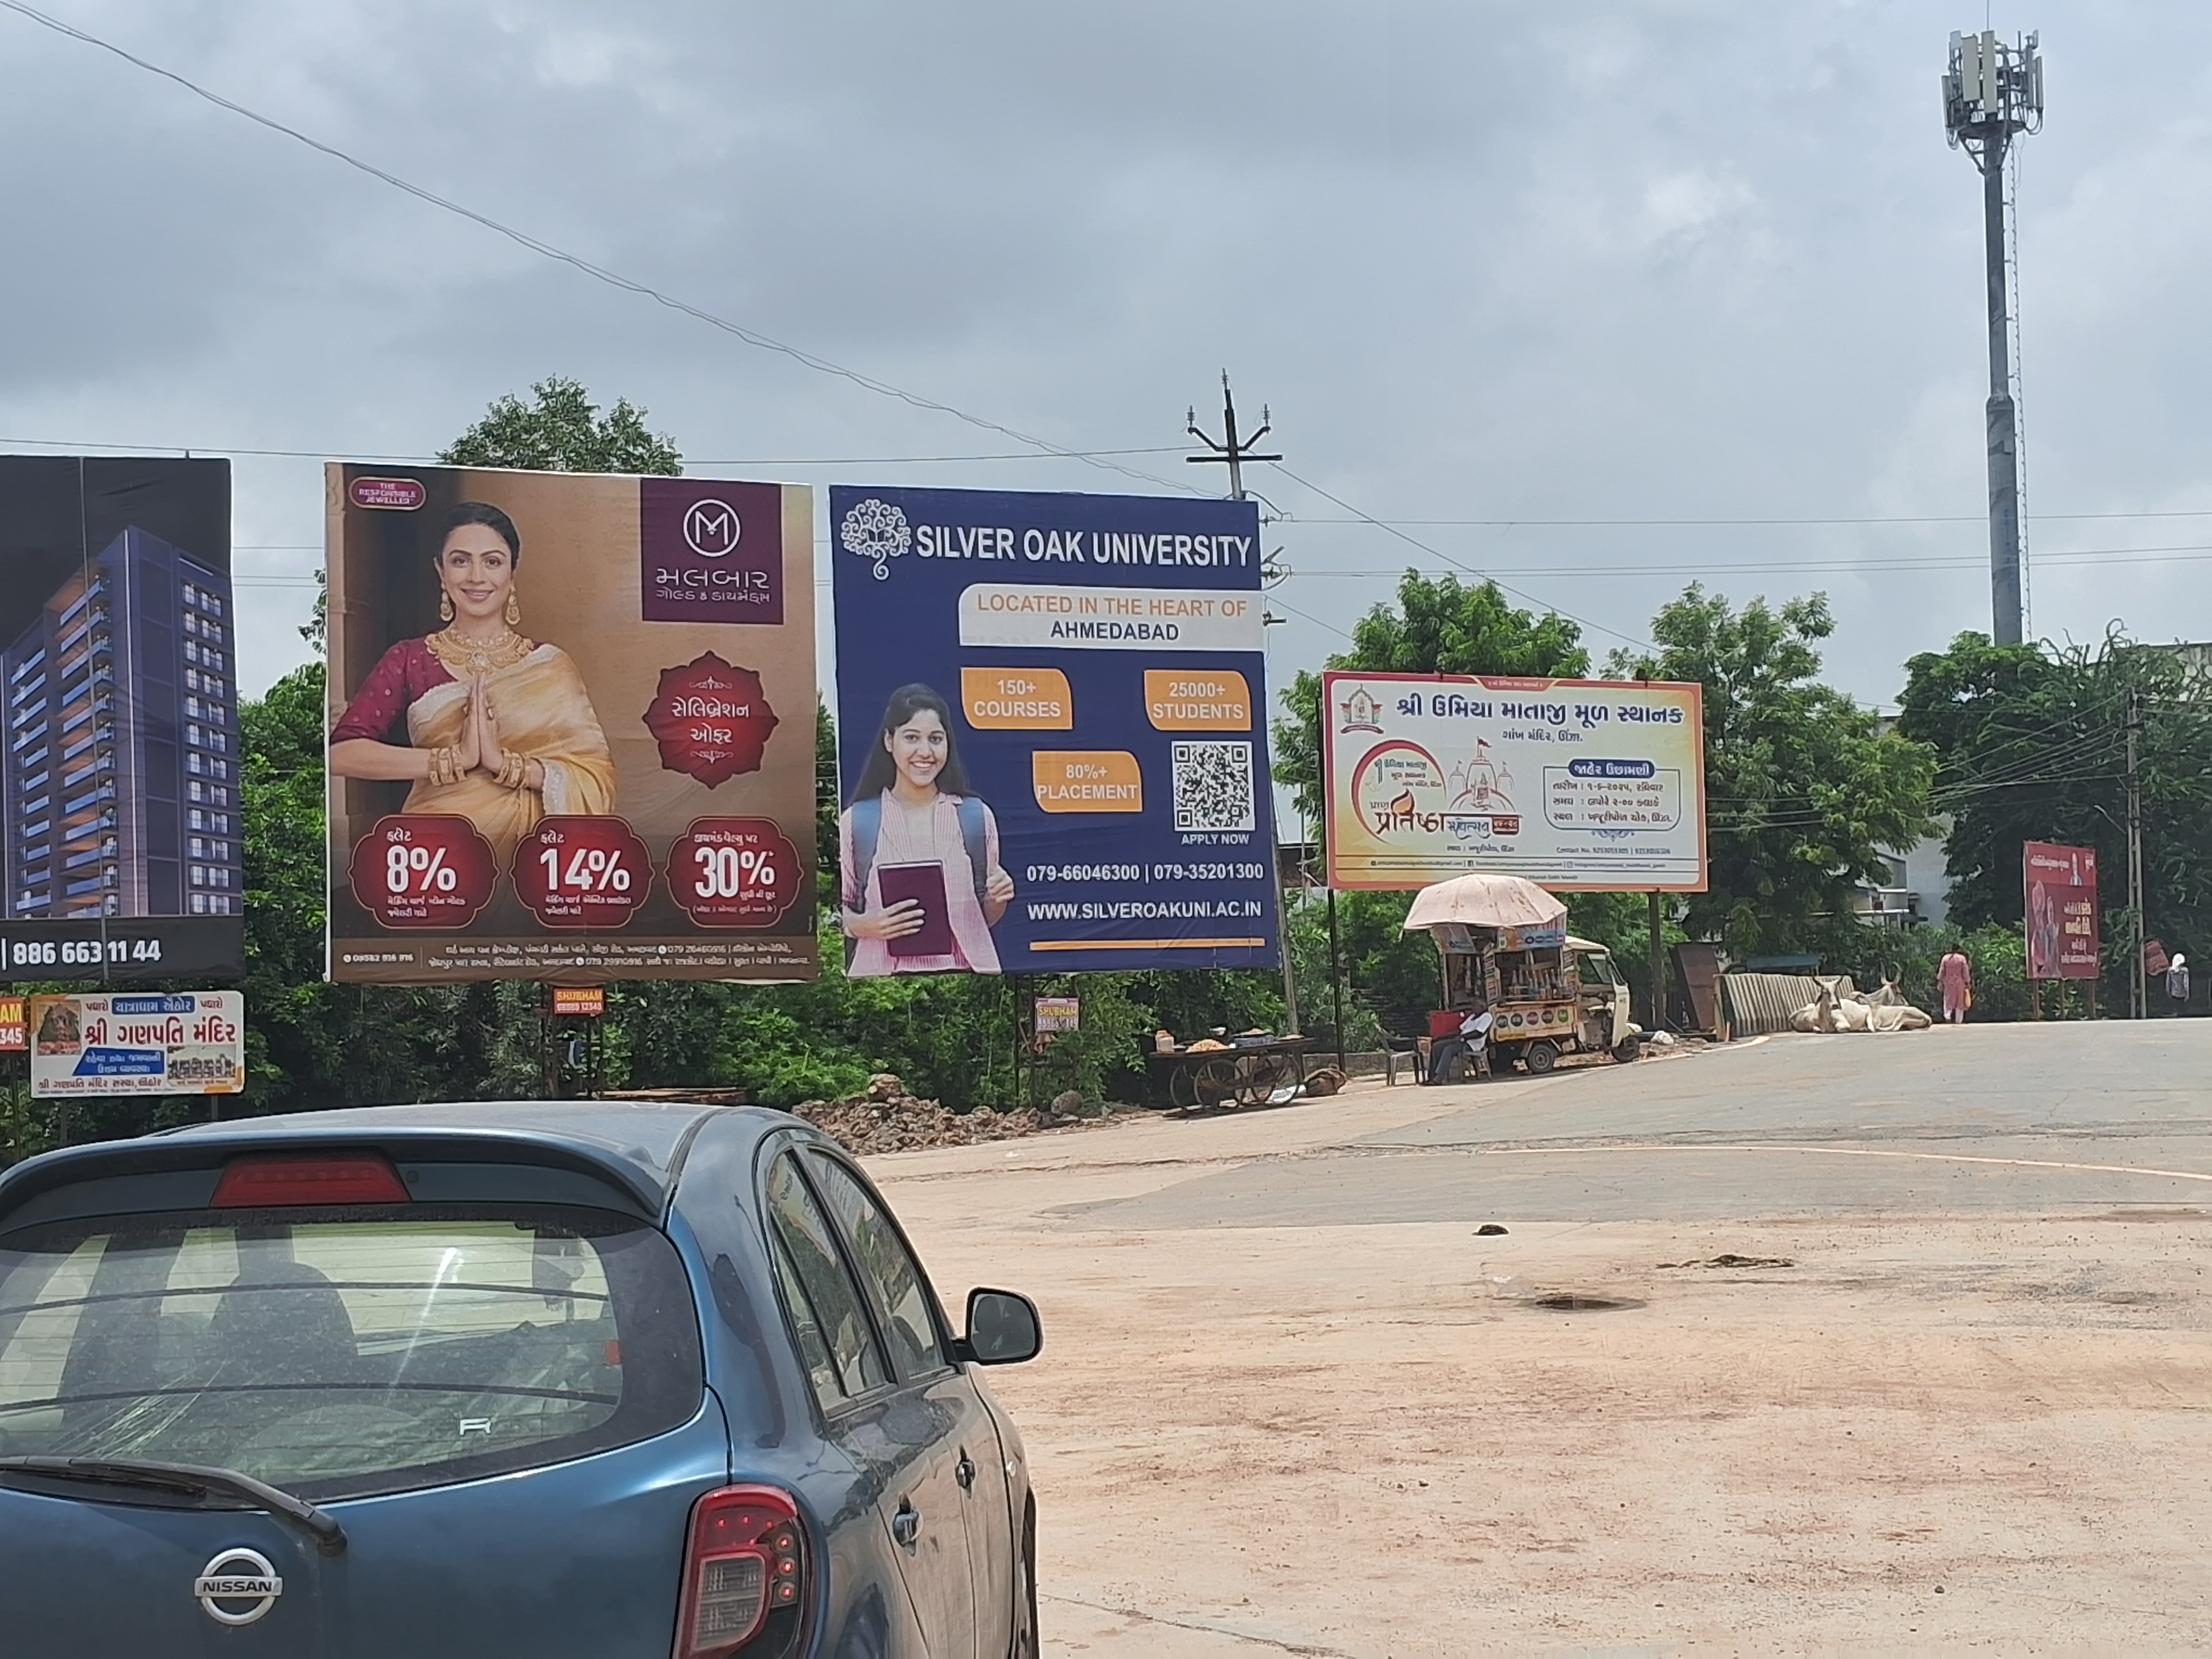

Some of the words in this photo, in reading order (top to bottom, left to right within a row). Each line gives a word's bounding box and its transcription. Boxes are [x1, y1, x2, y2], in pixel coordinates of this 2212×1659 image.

[916, 524, 1015, 561] SILVER
[1023, 528, 1085, 563] OAK
[1092, 531, 1253, 567] UNIVERSITY
[655, 568, 770, 589] મલબાર
[699, 591, 708, 601] &
[978, 593, 1072, 614] LOCATED
[1079, 596, 1098, 614] IN
[1105, 597, 1143, 615] THE
[1149, 599, 1216, 616] HEART
[1221, 600, 1247, 617] OF
[1050, 620, 1179, 641] AHMEDABAD
[997, 679, 1037, 696] 150+
[1169, 681, 1226, 698] 25000+
[671, 697, 749, 720] સેલિબ્રેશન
[973, 700, 1061, 717] COURSES
[1152, 703, 1244, 719] STUDENTS
[1396, 693, 1423, 717] શ્રી
[1431, 694, 1493, 719] ઉમિયા
[1501, 702, 1567, 725] માતાજી
[1574, 705, 1609, 729] મૂળ
[1617, 706, 1684, 724] સ્થાનક
[690, 724, 733, 744] ઓફર
[1066, 764, 1108, 780] 80%+
[1574, 761, 1603, 775] જાહેર
[1037, 784, 1139, 801] PLACEMENT
[1181, 834, 1218, 846] APPLY
[1220, 834, 1250, 845] NOW
[387, 844, 456, 893] 8%
[539, 848, 631, 891] 14%
[1027, 865, 1140, 883] 079-66046300
[1154, 864, 1264, 881] 079-35201300
[1027, 900, 1262, 920] WWW.SILVEROAKUNI.AC.IN
[13, 942, 56, 964] 886
[62, 941, 102, 963] 663
[107, 940, 127, 962] 11
[132, 940, 162, 961] 44
[86, 999, 108, 1012] પધારો
[556, 991, 603, 1001] SHUBHAM
[85, 1018, 108, 1045] શ્રી
[117, 1016, 184, 1044] ગણપતિ
[193, 1015, 236, 1043] મંદિર
[203, 1581, 272, 1592] NISSAN
